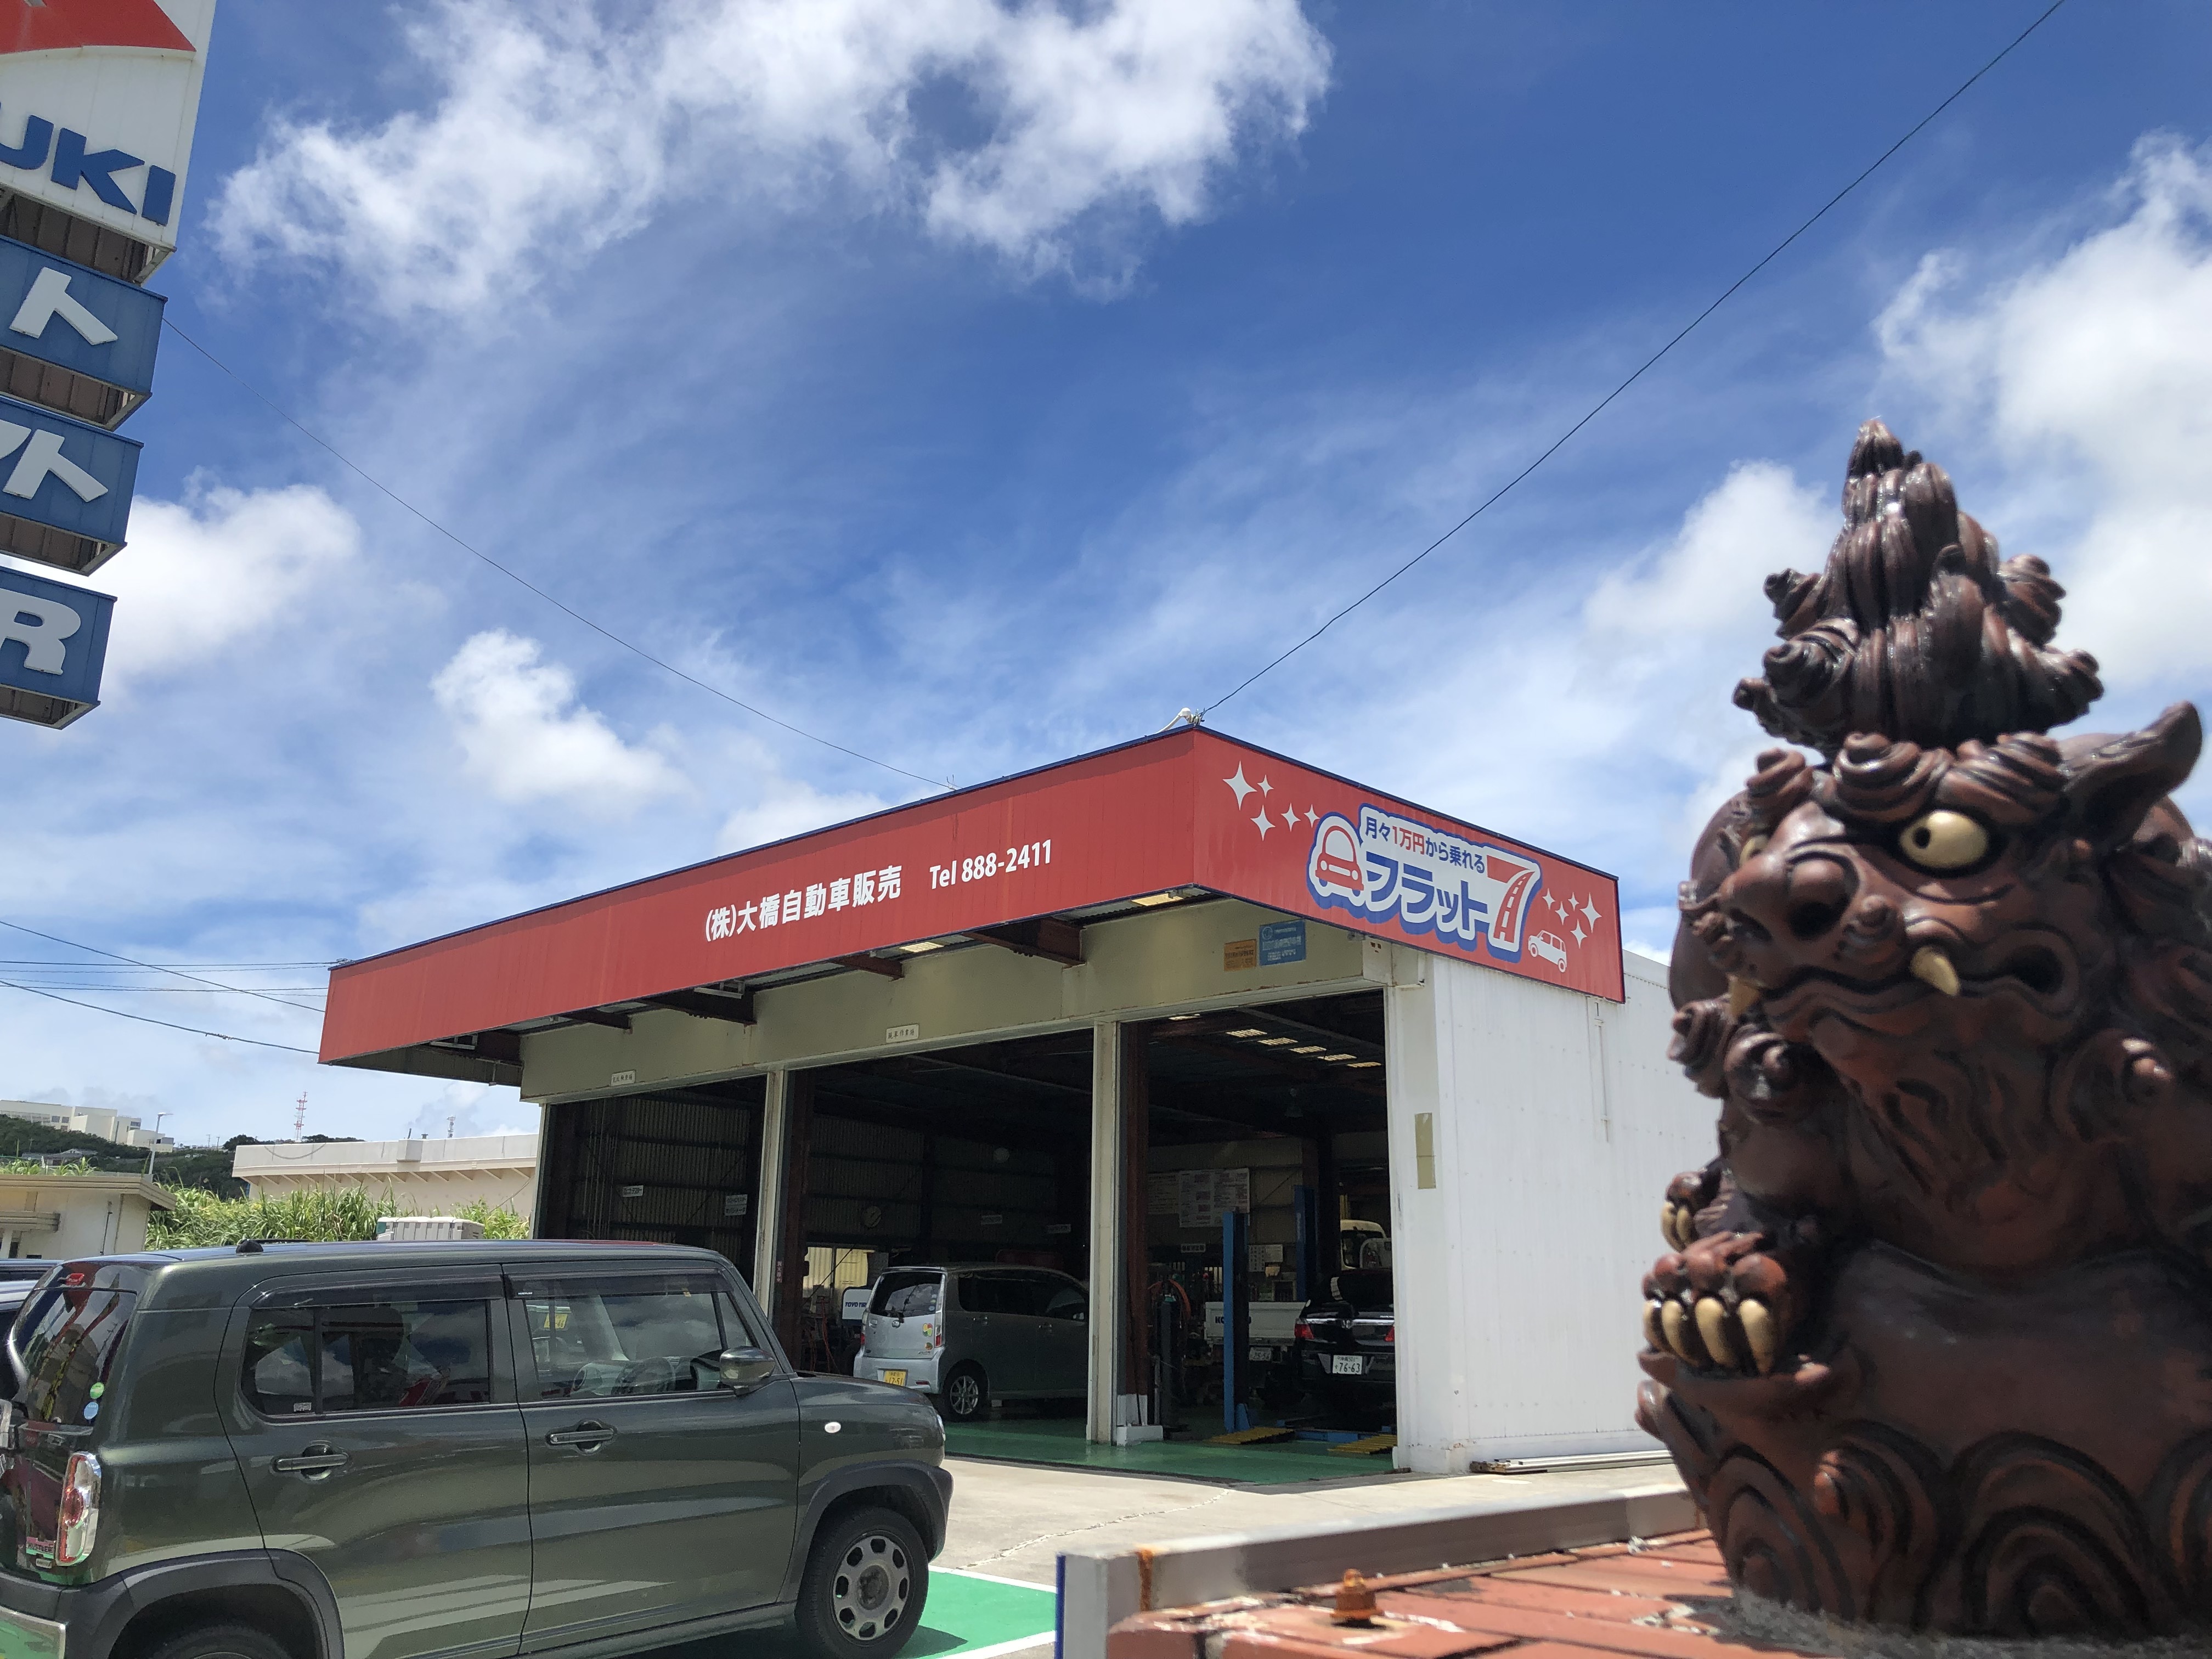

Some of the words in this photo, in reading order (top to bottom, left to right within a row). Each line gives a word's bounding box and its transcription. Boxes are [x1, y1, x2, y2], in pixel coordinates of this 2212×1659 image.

[9, 267, 118, 345] ト
[1365, 816, 1485, 874] 月々1万円から乗れる
[706, 865, 902, 942] (株)大橋自動車販売
[929, 860, 957, 890] Tel
[961, 839, 1051, 883] 888-2411
